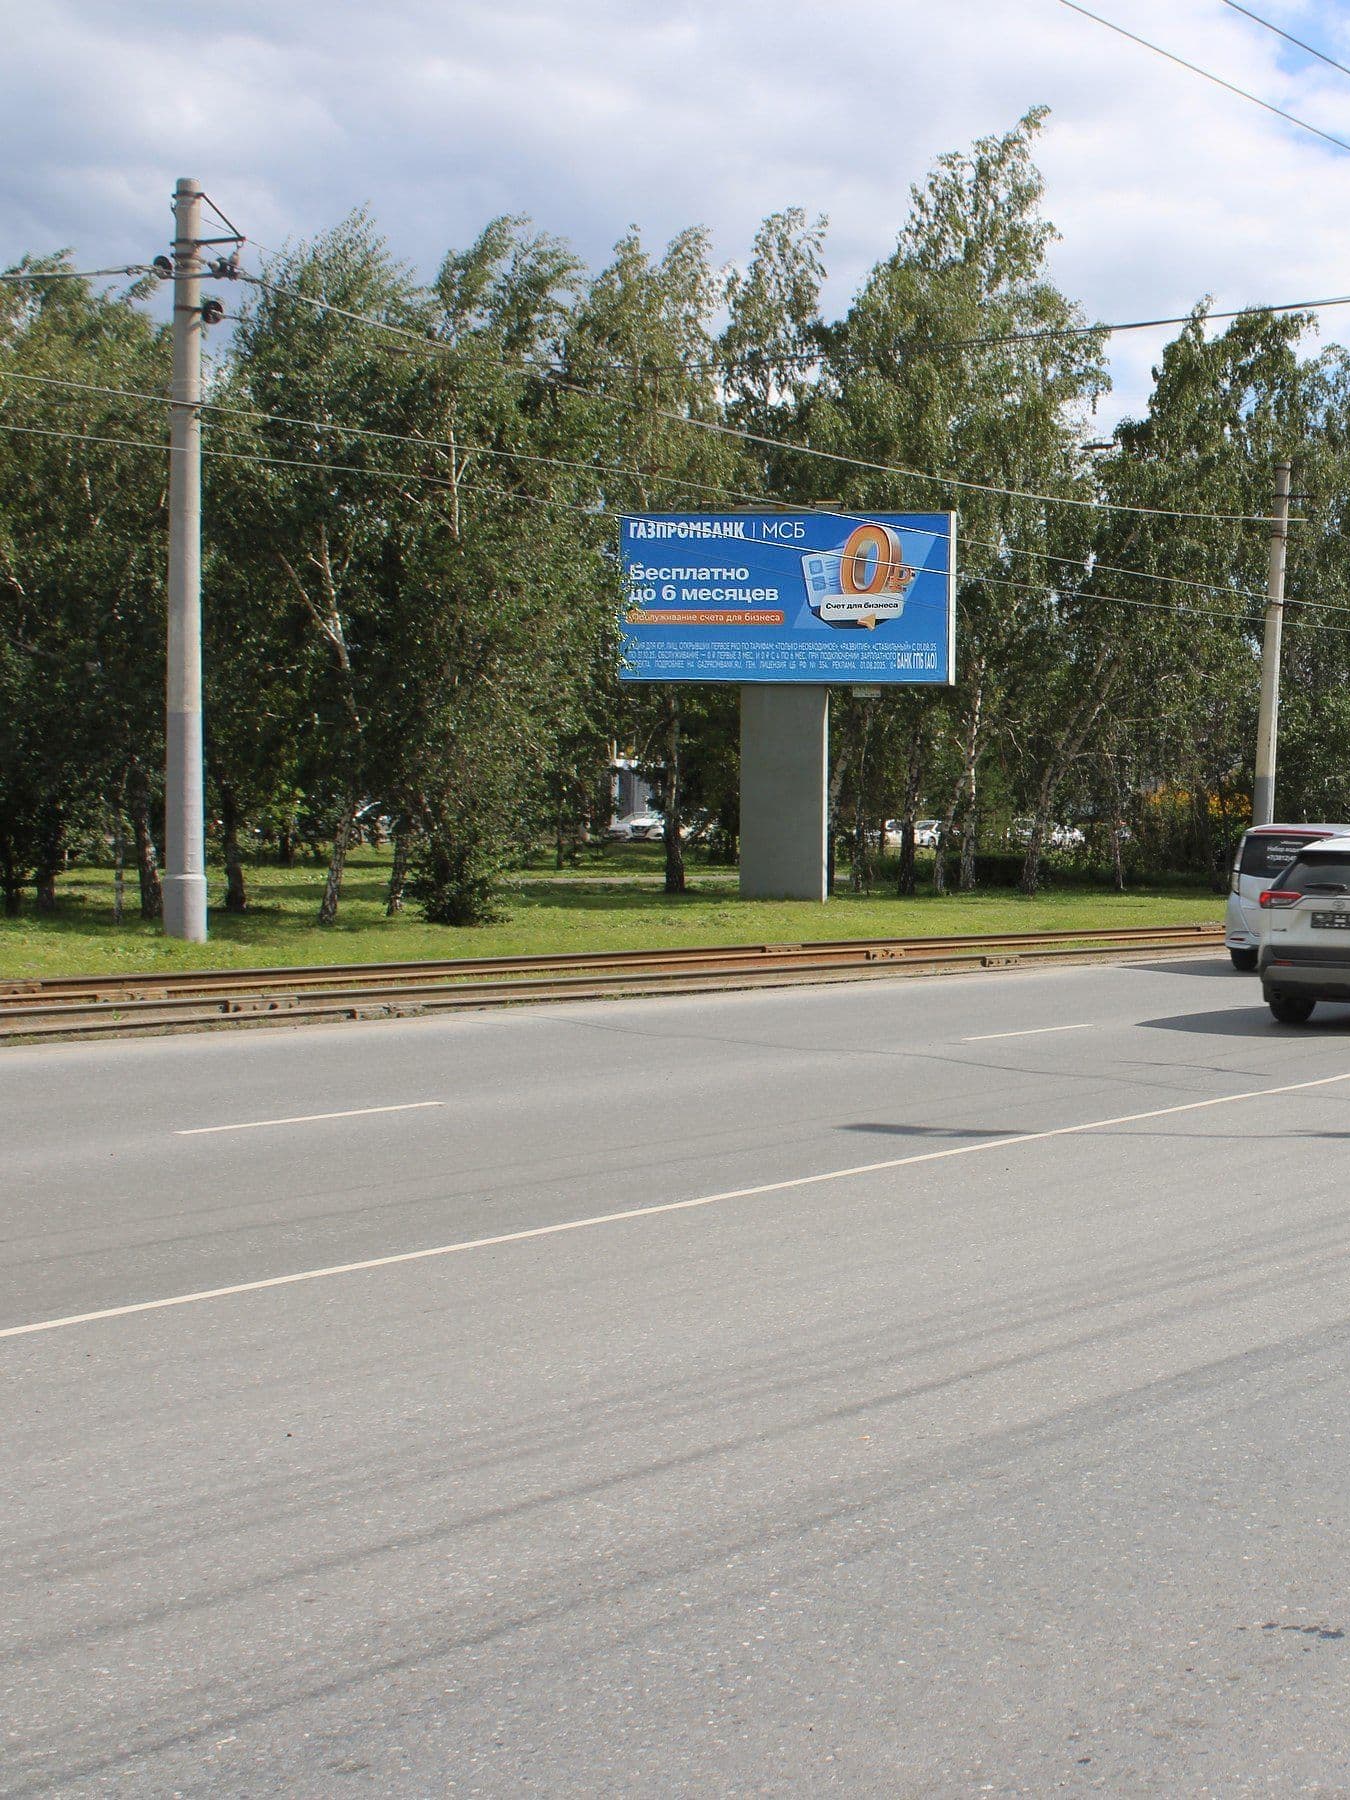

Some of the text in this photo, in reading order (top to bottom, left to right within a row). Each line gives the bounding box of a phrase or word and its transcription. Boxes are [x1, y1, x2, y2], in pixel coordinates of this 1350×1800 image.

[629, 521, 806, 539] ГАЗПРОМБАНК МСБ
[629, 564, 750, 581] Бесплатно
[628, 585, 779, 604] до 6 месяцев
[825, 601, 899, 611] Счет для бизнеса
[700, 614, 724, 622] счета
[726, 614, 743, 623] для
[744, 613, 781, 622] бизнеса
